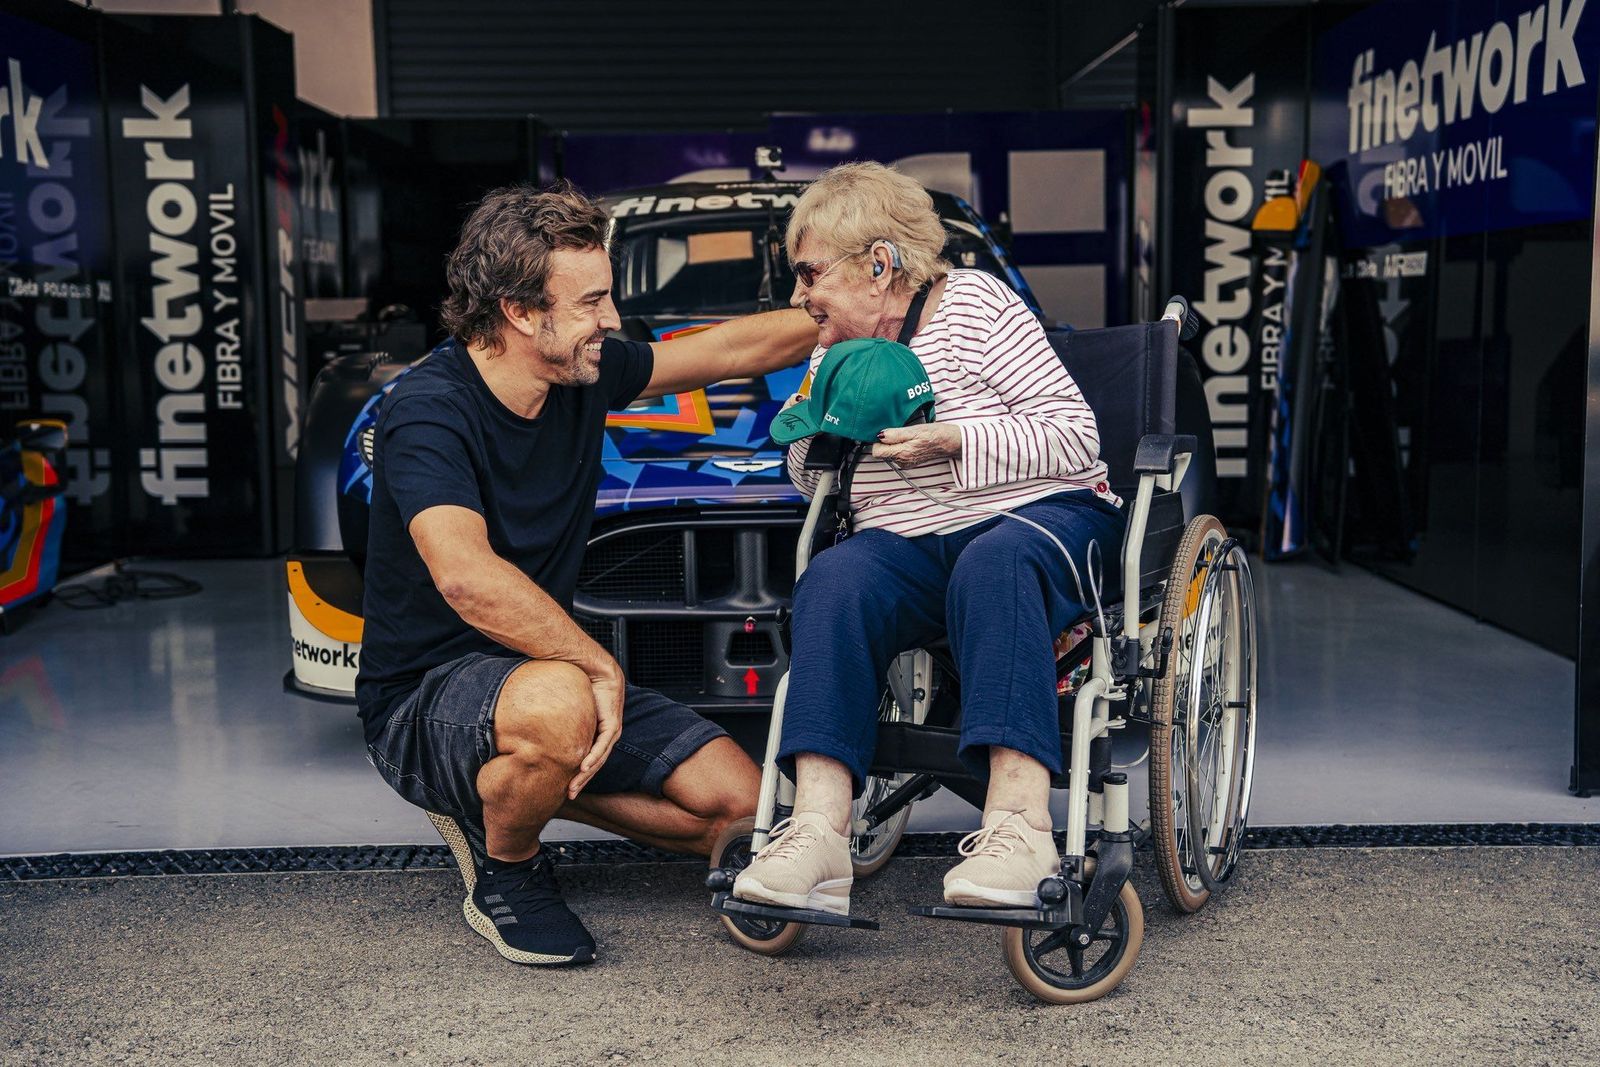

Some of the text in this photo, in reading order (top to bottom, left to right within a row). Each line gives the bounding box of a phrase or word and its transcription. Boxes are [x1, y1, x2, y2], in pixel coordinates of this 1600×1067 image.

[1347, 0, 1587, 154] finetwork
[1383, 134, 1509, 201] FIBRA Y MOVIL
[122, 82, 210, 506] finetwork
[208, 182, 244, 410] FIBRA Y MOVIL
[1262, 273, 1286, 295] Y
[906, 382, 931, 400] BOSS
